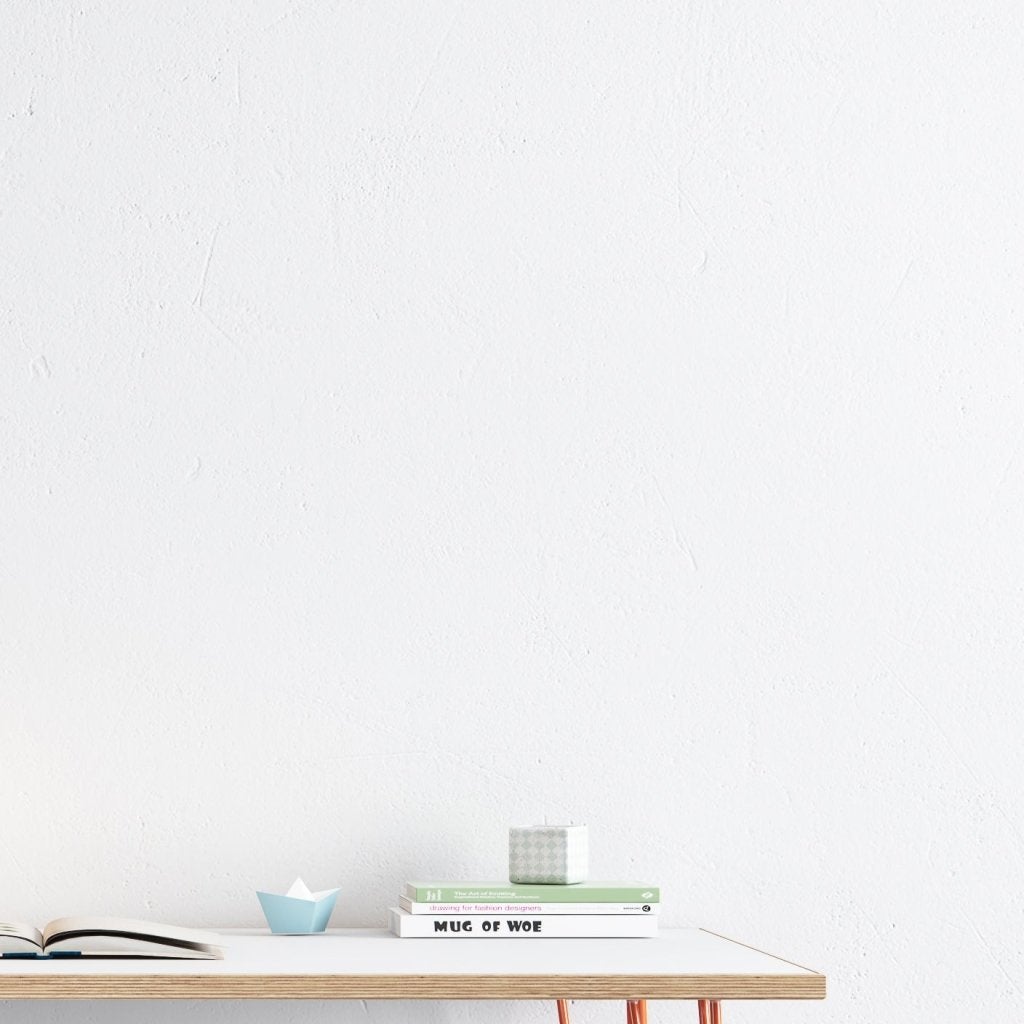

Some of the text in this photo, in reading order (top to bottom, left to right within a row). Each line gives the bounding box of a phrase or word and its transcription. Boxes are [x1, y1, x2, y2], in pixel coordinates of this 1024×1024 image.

[433, 920, 542, 932] MUG OF WOE
